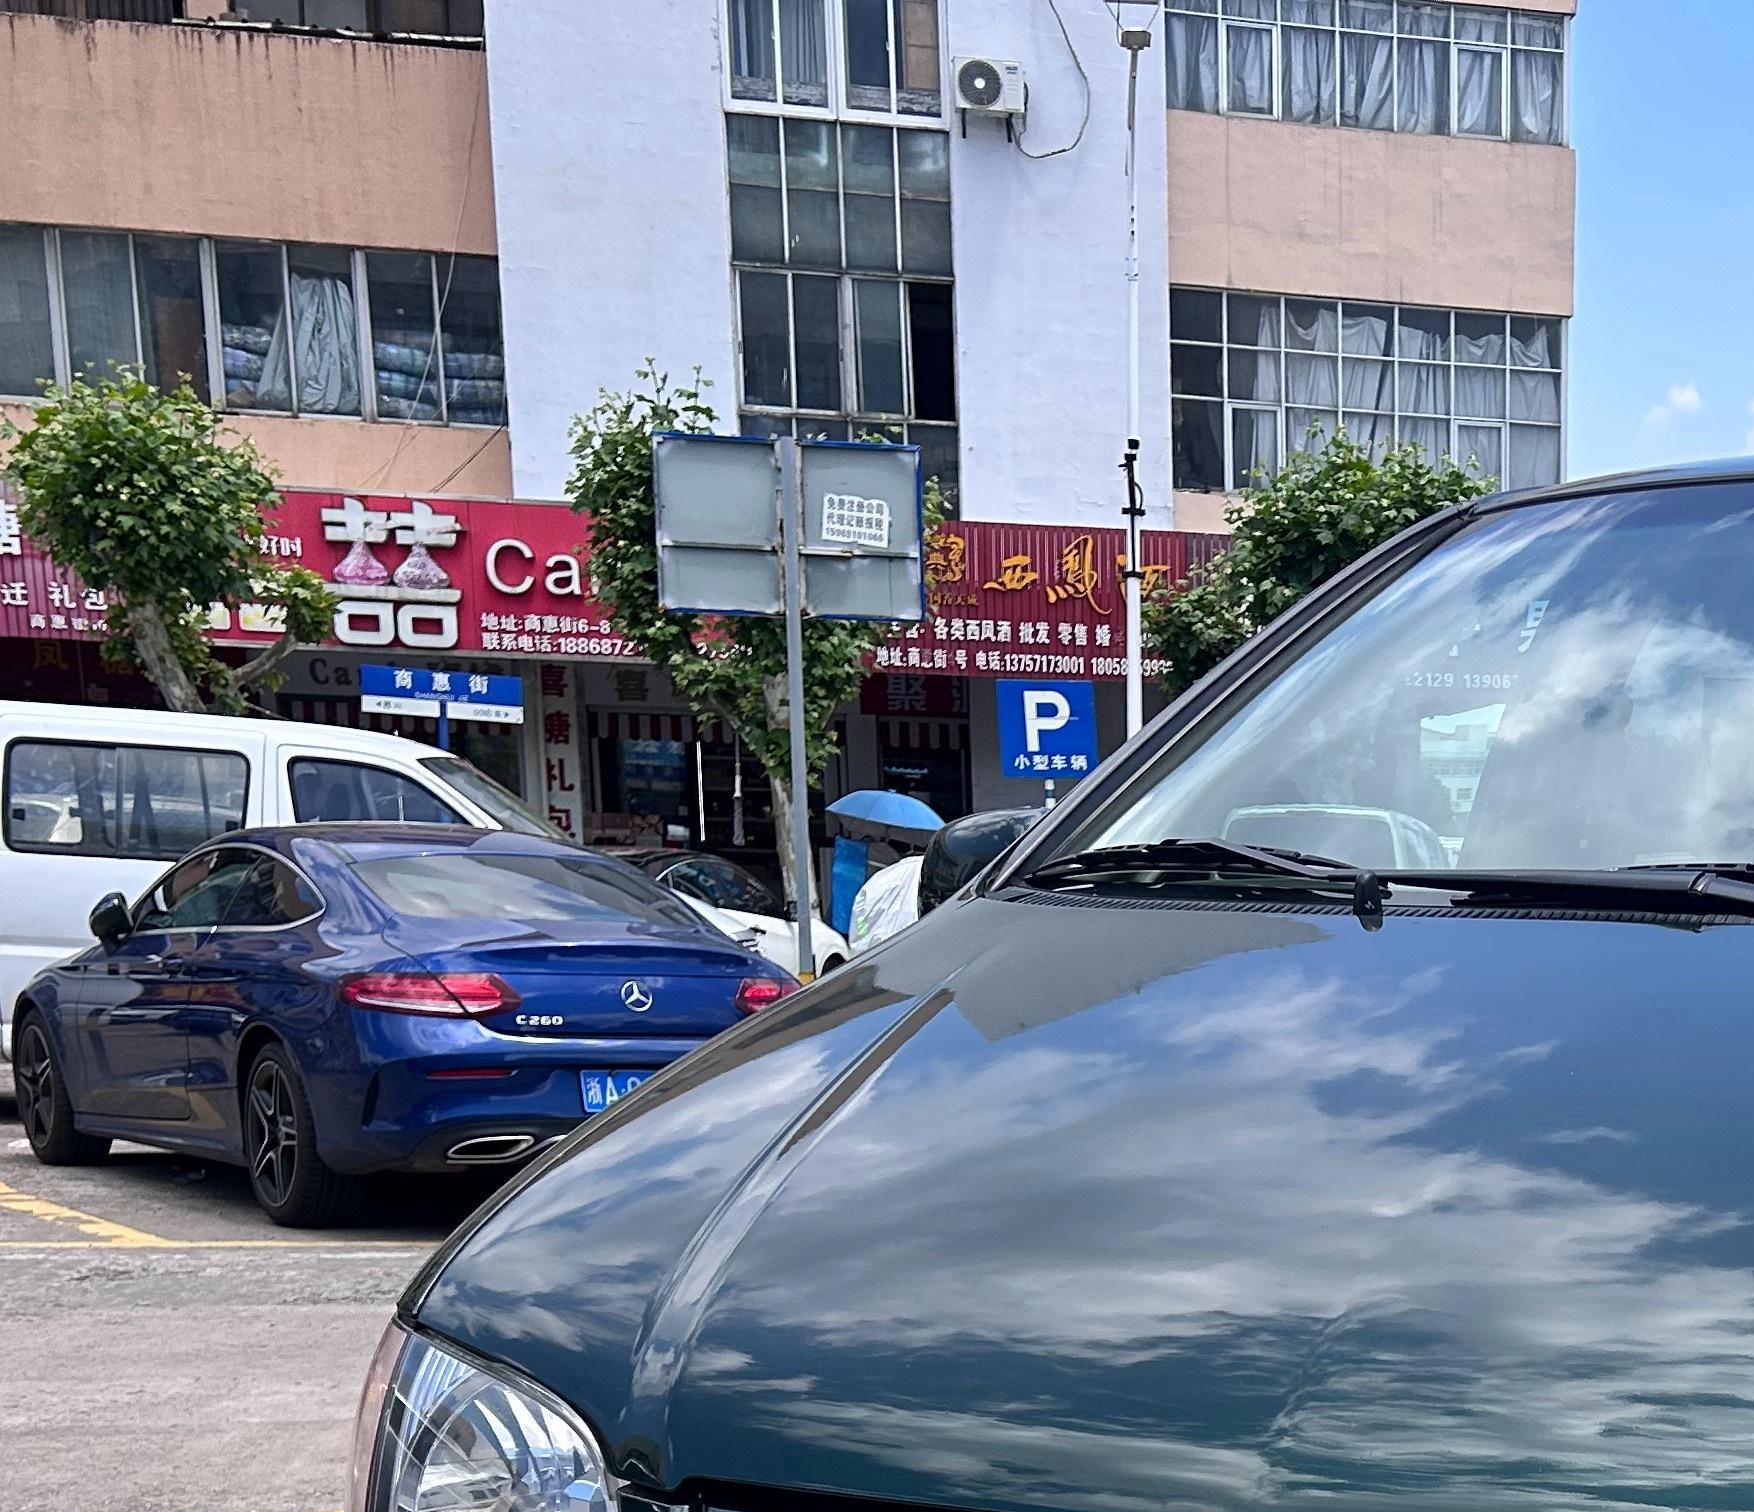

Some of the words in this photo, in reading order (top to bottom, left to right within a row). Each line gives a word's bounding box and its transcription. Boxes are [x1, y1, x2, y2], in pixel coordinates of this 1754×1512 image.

[485, 538, 599, 596] Ca
[482, 631, 640, 656] 联系电话:1886872
[1019, 621, 1050, 645] 批发
[1058, 622, 1088, 646] 零售
[393, 668, 489, 695] 商惠街
[1463, 673, 1519, 689] 13906
[1023, 690, 1070, 752] P
[1014, 753, 1088, 771] 小型车辆
